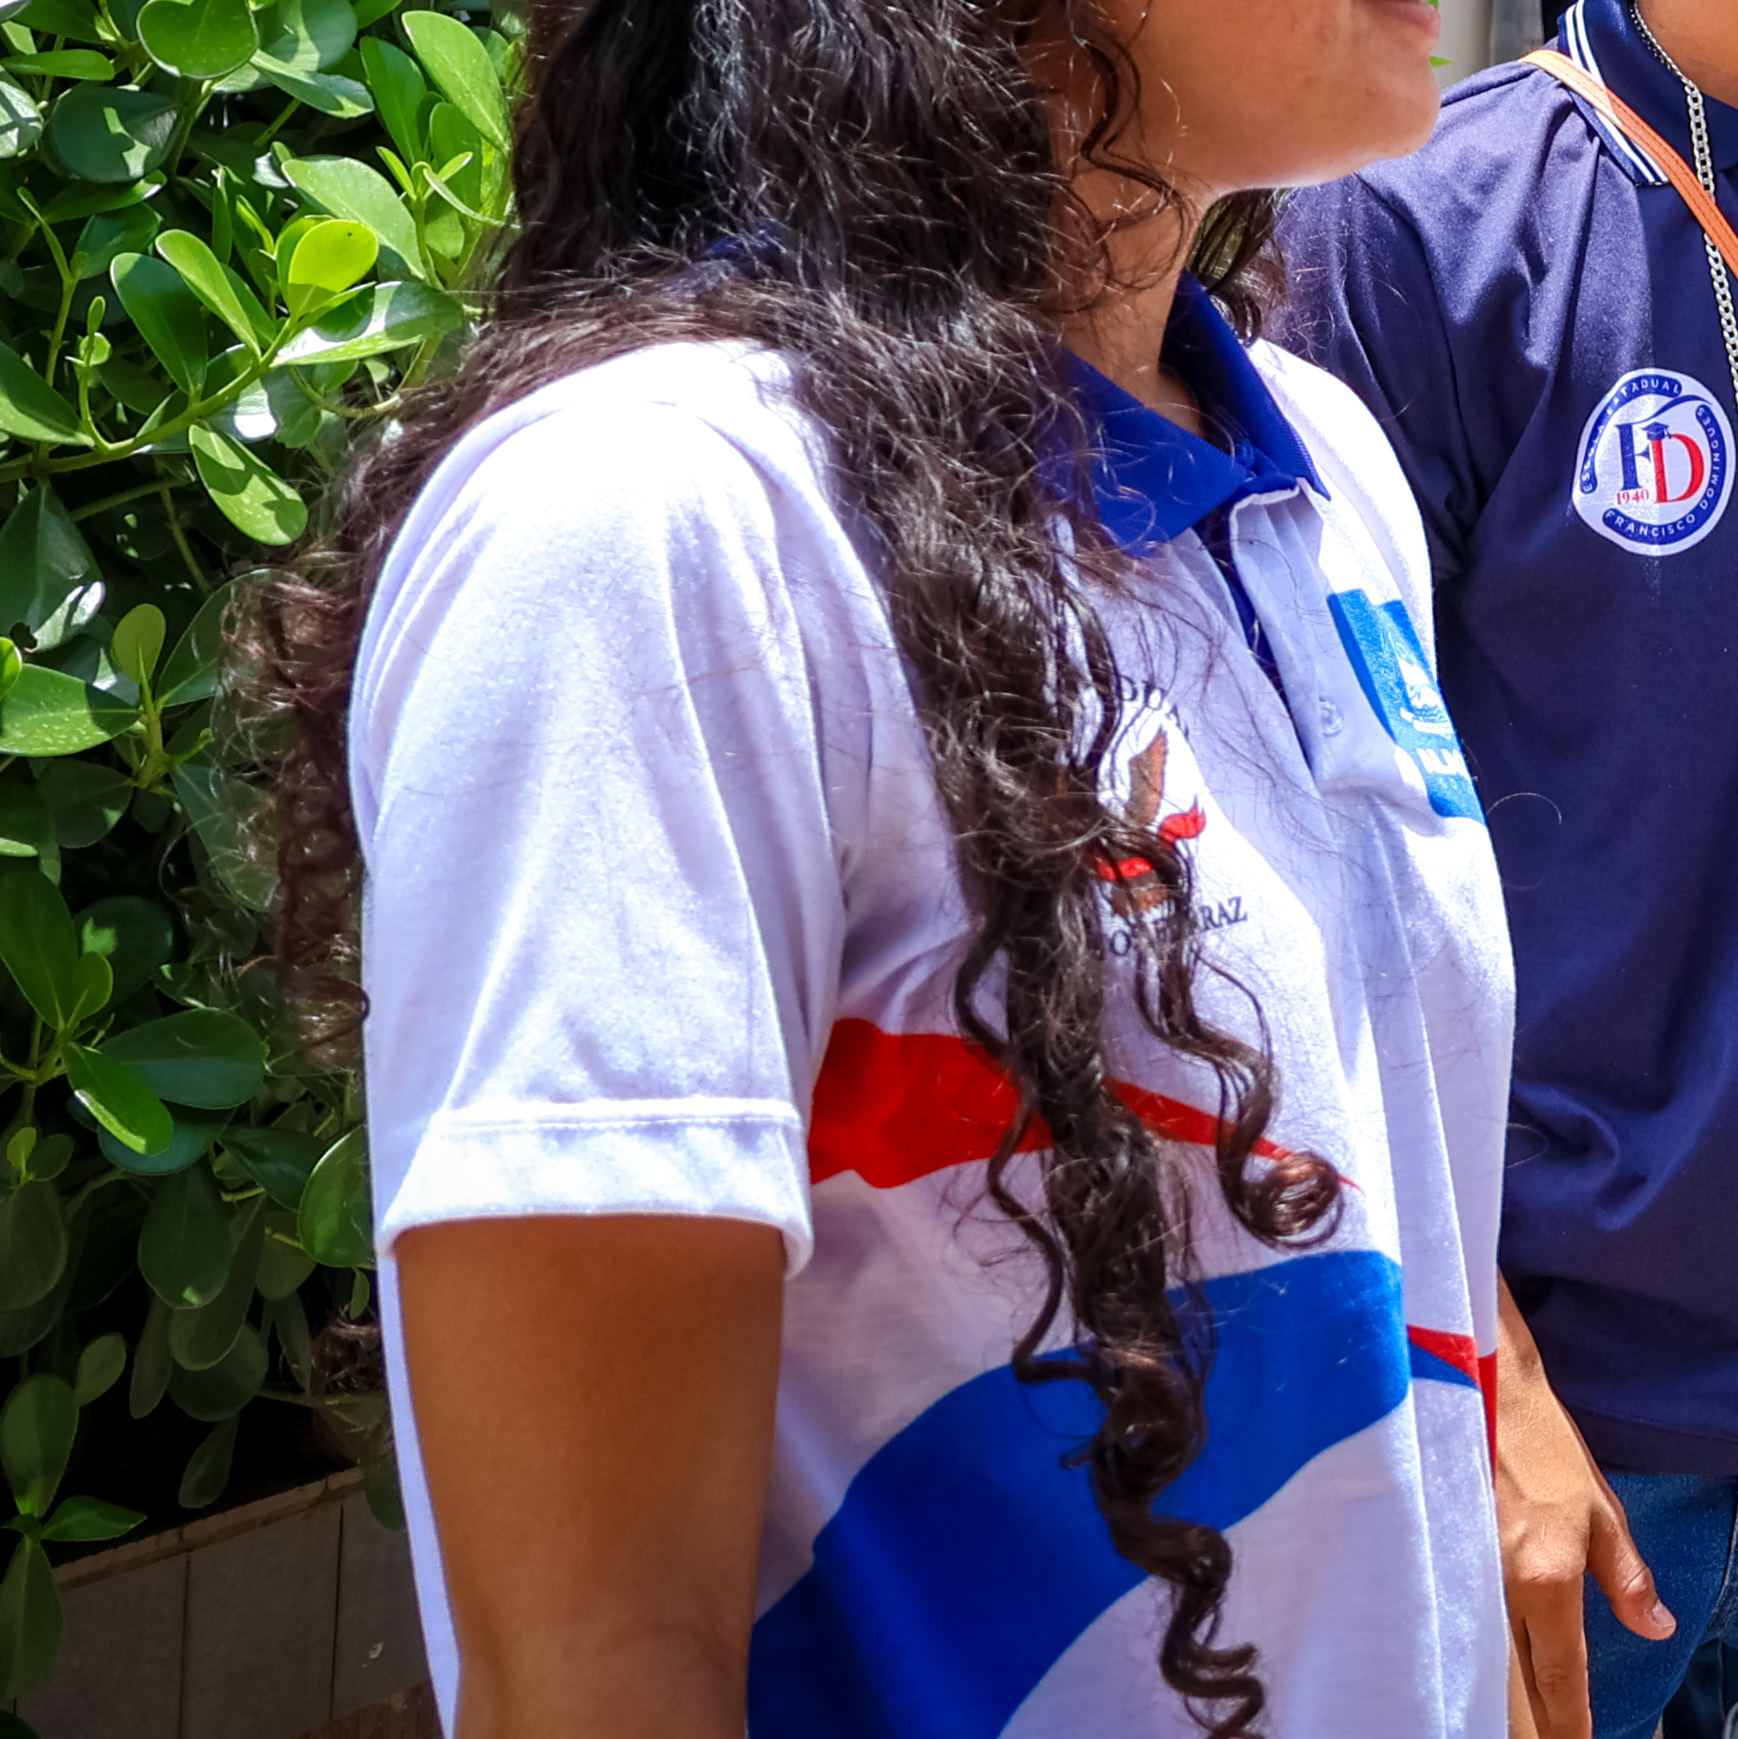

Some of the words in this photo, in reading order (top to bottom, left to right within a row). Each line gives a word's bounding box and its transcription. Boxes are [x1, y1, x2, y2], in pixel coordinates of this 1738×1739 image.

[1604, 510, 1696, 538] FRANCISCO
[1696, 407, 1721, 510] DOMINGUES
[1616, 489, 1650, 505] 1940
